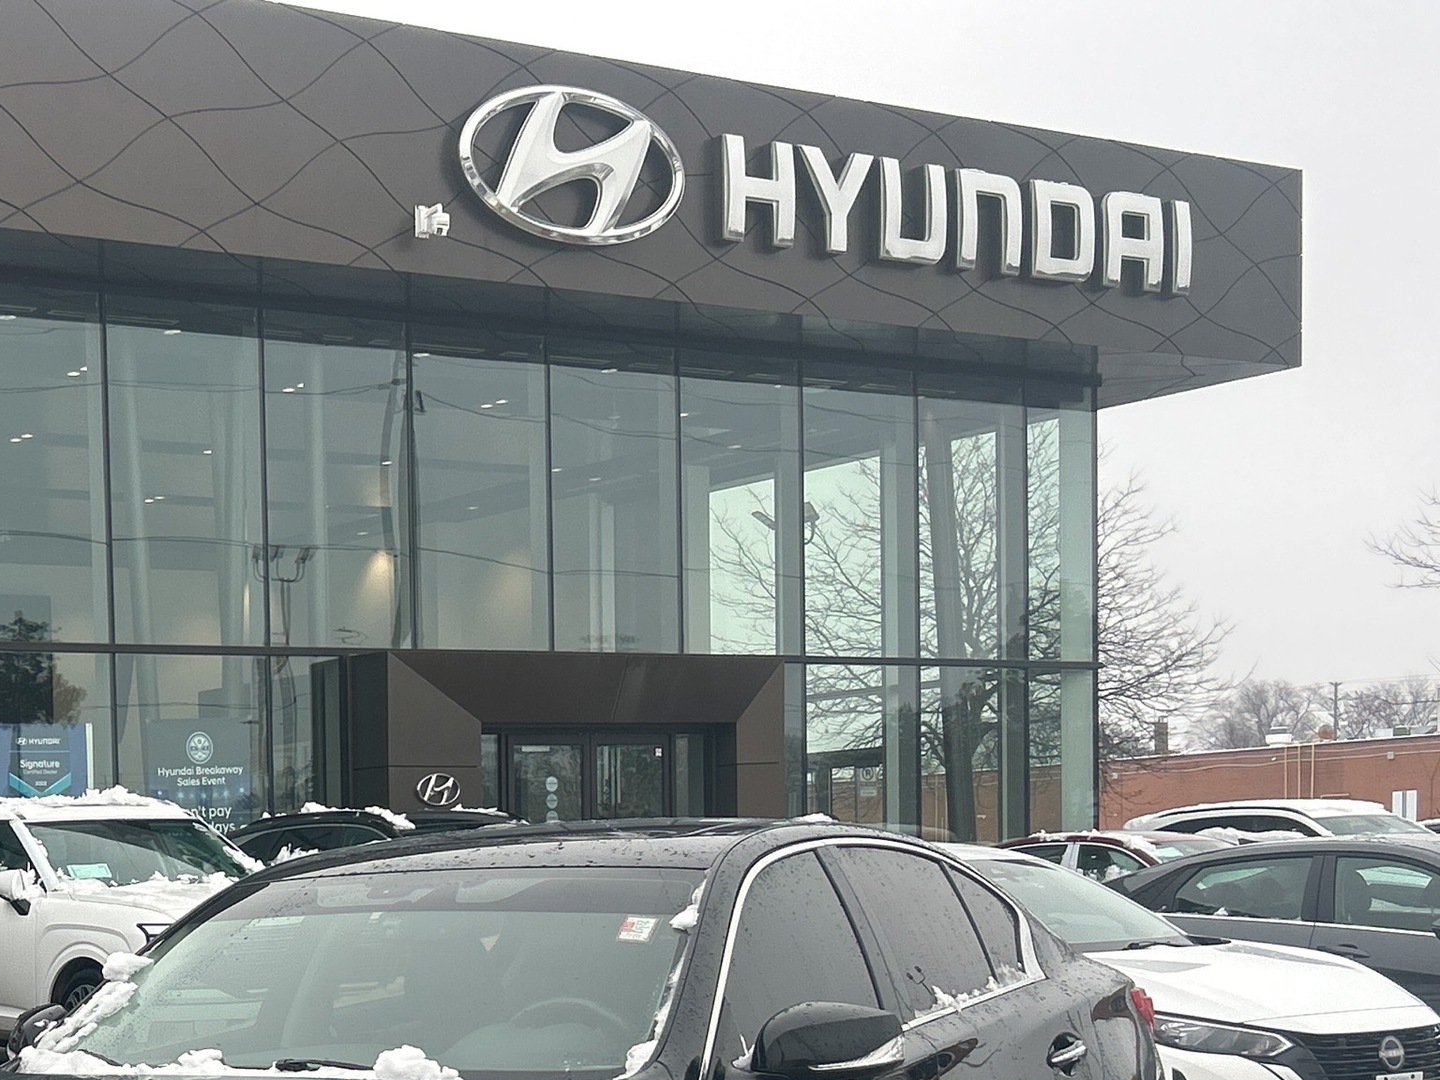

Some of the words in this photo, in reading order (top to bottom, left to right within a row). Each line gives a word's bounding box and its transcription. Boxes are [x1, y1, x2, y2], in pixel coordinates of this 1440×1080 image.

[720, 132, 1193, 298] HYUNDAI
[20, 759, 60, 769] Signature
[157, 766, 194, 777] Hyundai
[195, 765, 244, 776] Breakaway
[177, 777, 200, 786] Sales
[201, 776, 226, 786] Event
[208, 807, 232, 819] pay
